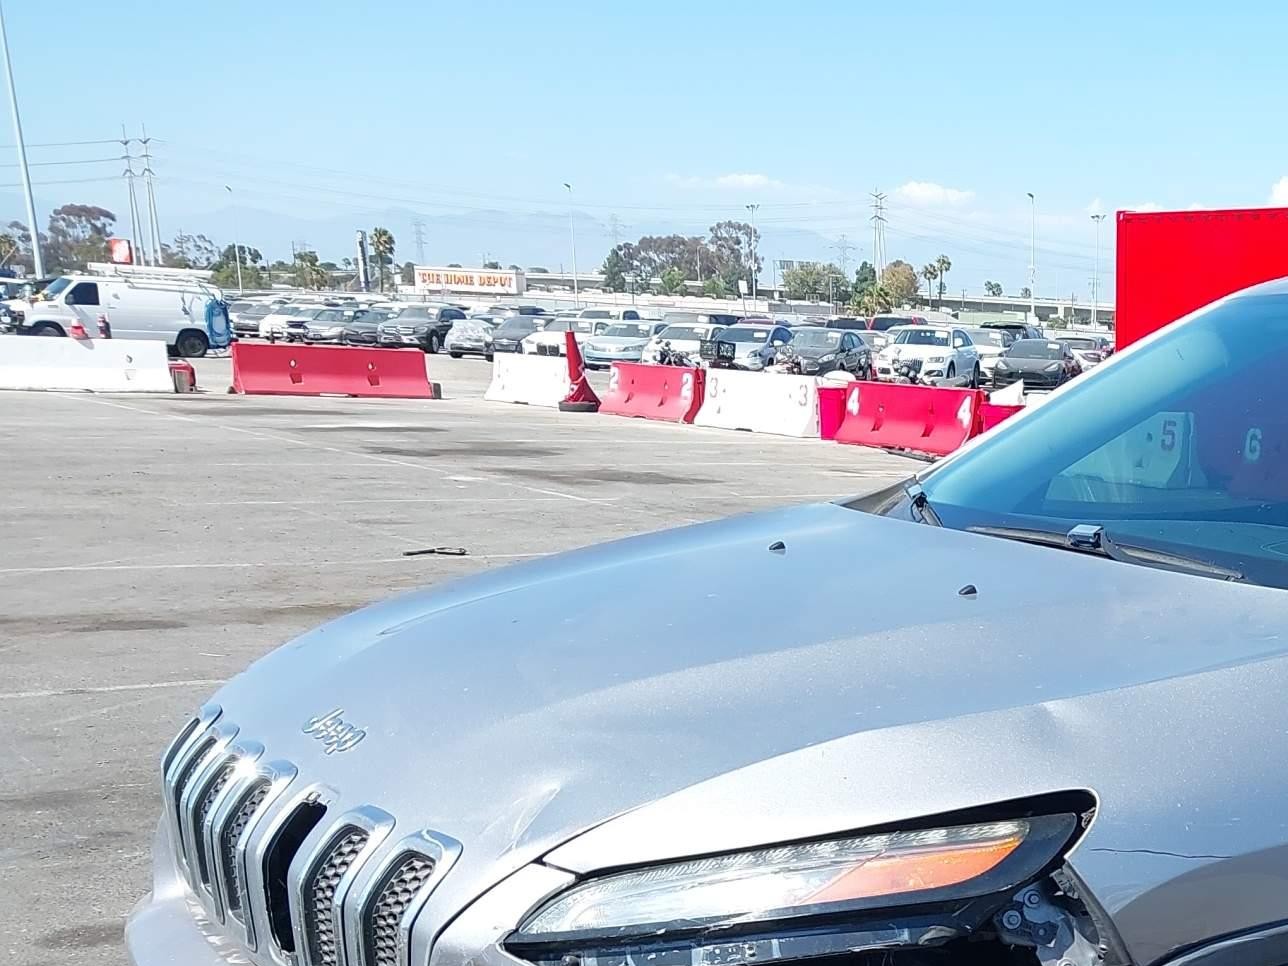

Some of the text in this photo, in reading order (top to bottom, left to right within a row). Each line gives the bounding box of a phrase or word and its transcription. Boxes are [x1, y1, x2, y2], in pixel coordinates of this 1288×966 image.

[443, 272, 475, 286] HOME
[478, 274, 513, 288] DEPOT
[609, 366, 620, 392] 2
[681, 372, 694, 399] 2
[709, 377, 719, 399] 3
[798, 384, 808, 407] 3
[847, 386, 860, 416] 4
[956, 395, 972, 430] 4
[1160, 420, 1177, 451] 5
[302, 707, 367, 755] Jeep
